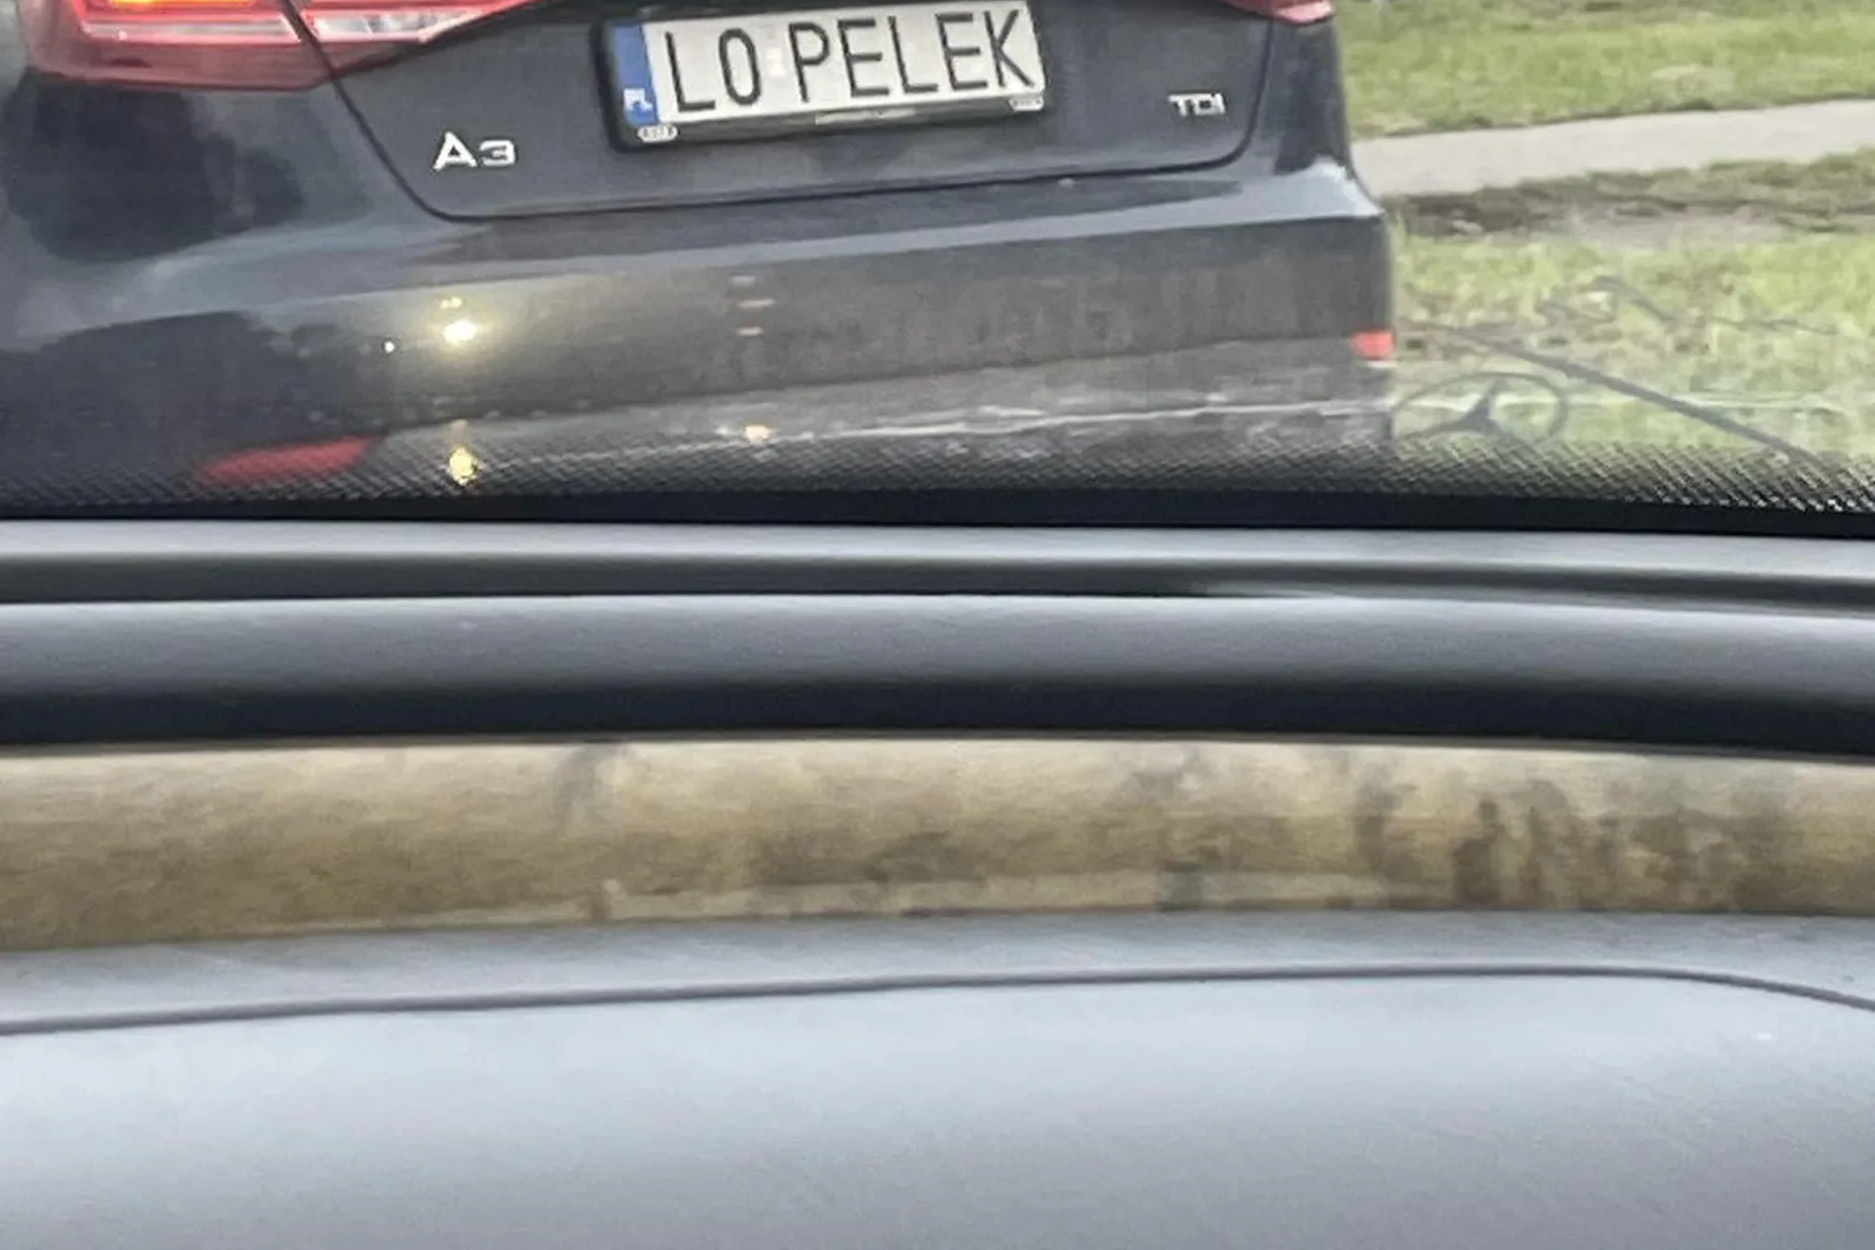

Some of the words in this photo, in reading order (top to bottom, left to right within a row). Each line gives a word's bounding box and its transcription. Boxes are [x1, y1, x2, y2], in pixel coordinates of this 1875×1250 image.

[787, 8, 1035, 103] PELEK
[1167, 92, 1225, 117] TDI
[432, 131, 516, 171] A3
